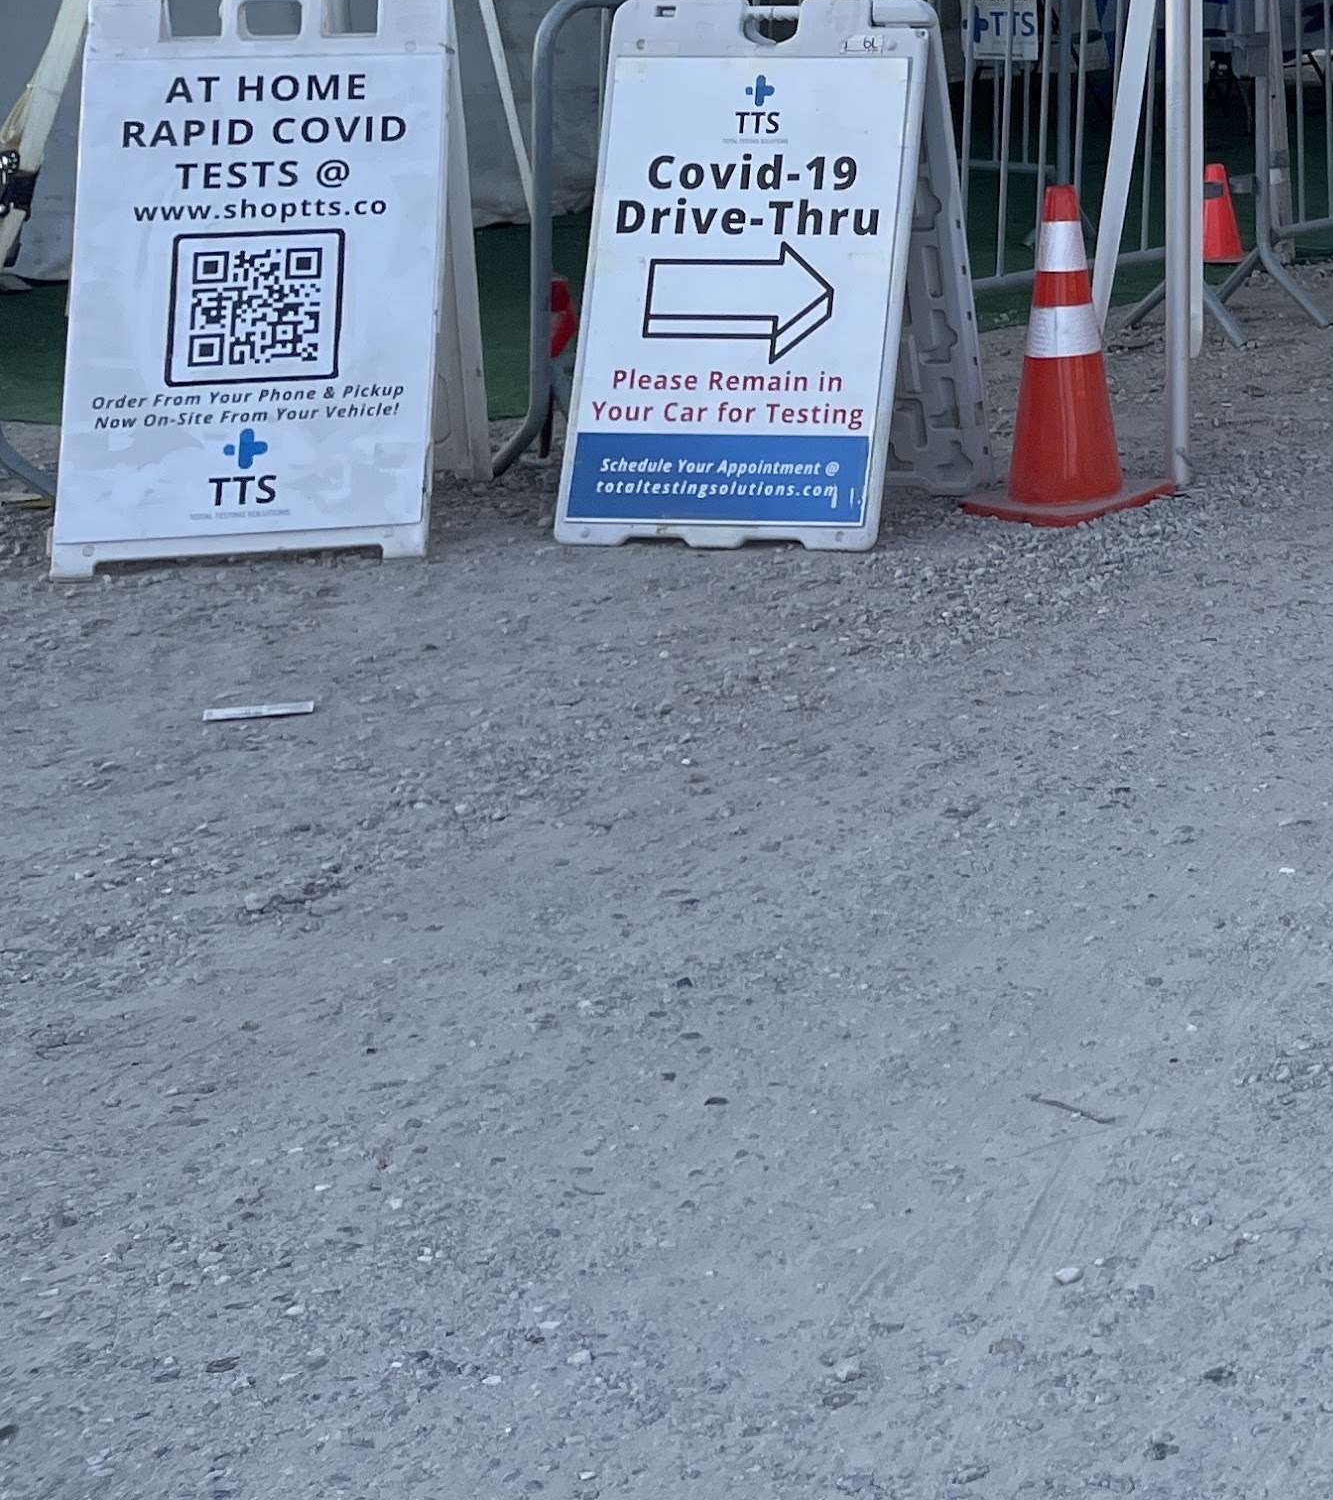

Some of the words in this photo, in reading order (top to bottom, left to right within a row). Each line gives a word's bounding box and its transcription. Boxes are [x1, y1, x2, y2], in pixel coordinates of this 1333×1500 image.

[990, 11, 1035, 37] TTS
[166, 76, 221, 103] AT
[238, 73, 366, 102] HOME
[122, 118, 254, 148] RAPID
[272, 115, 408, 145] COVID
[736, 111, 781, 135] TTS
[175, 160, 299, 190] TESTS
[316, 159, 351, 188] @
[648, 153, 858, 192] Covid-19
[133, 196, 388, 225] www.shoptts.co
[615, 199, 880, 236] Drive-Thru
[612, 369, 698, 391] Please
[708, 370, 808, 392] Remain
[818, 370, 843, 393] in
[92, 393, 148, 411] Order
[153, 392, 201, 408] From
[210, 390, 253, 405] Your
[259, 387, 317, 403] Phone
[323, 386, 336, 401] &
[342, 382, 405, 402] Pickup
[95, 414, 138, 430] Now
[143, 410, 214, 428] On-Site
[220, 409, 268, 424] From
[276, 406, 320, 422] Your
[325, 401, 401, 419] Vehicle!
[592, 401, 654, 423] Your
[663, 401, 709, 423] Car
[717, 401, 757, 424] for
[765, 402, 864, 431] Testing
[600, 457, 673, 474] Schedule
[677, 458, 713, 474] Your
[716, 458, 821, 480] Appointment
[825, 461, 840, 477] @
[209, 475, 277, 507] TTS
[596, 479, 838, 499] totaltestingsolutions.com
